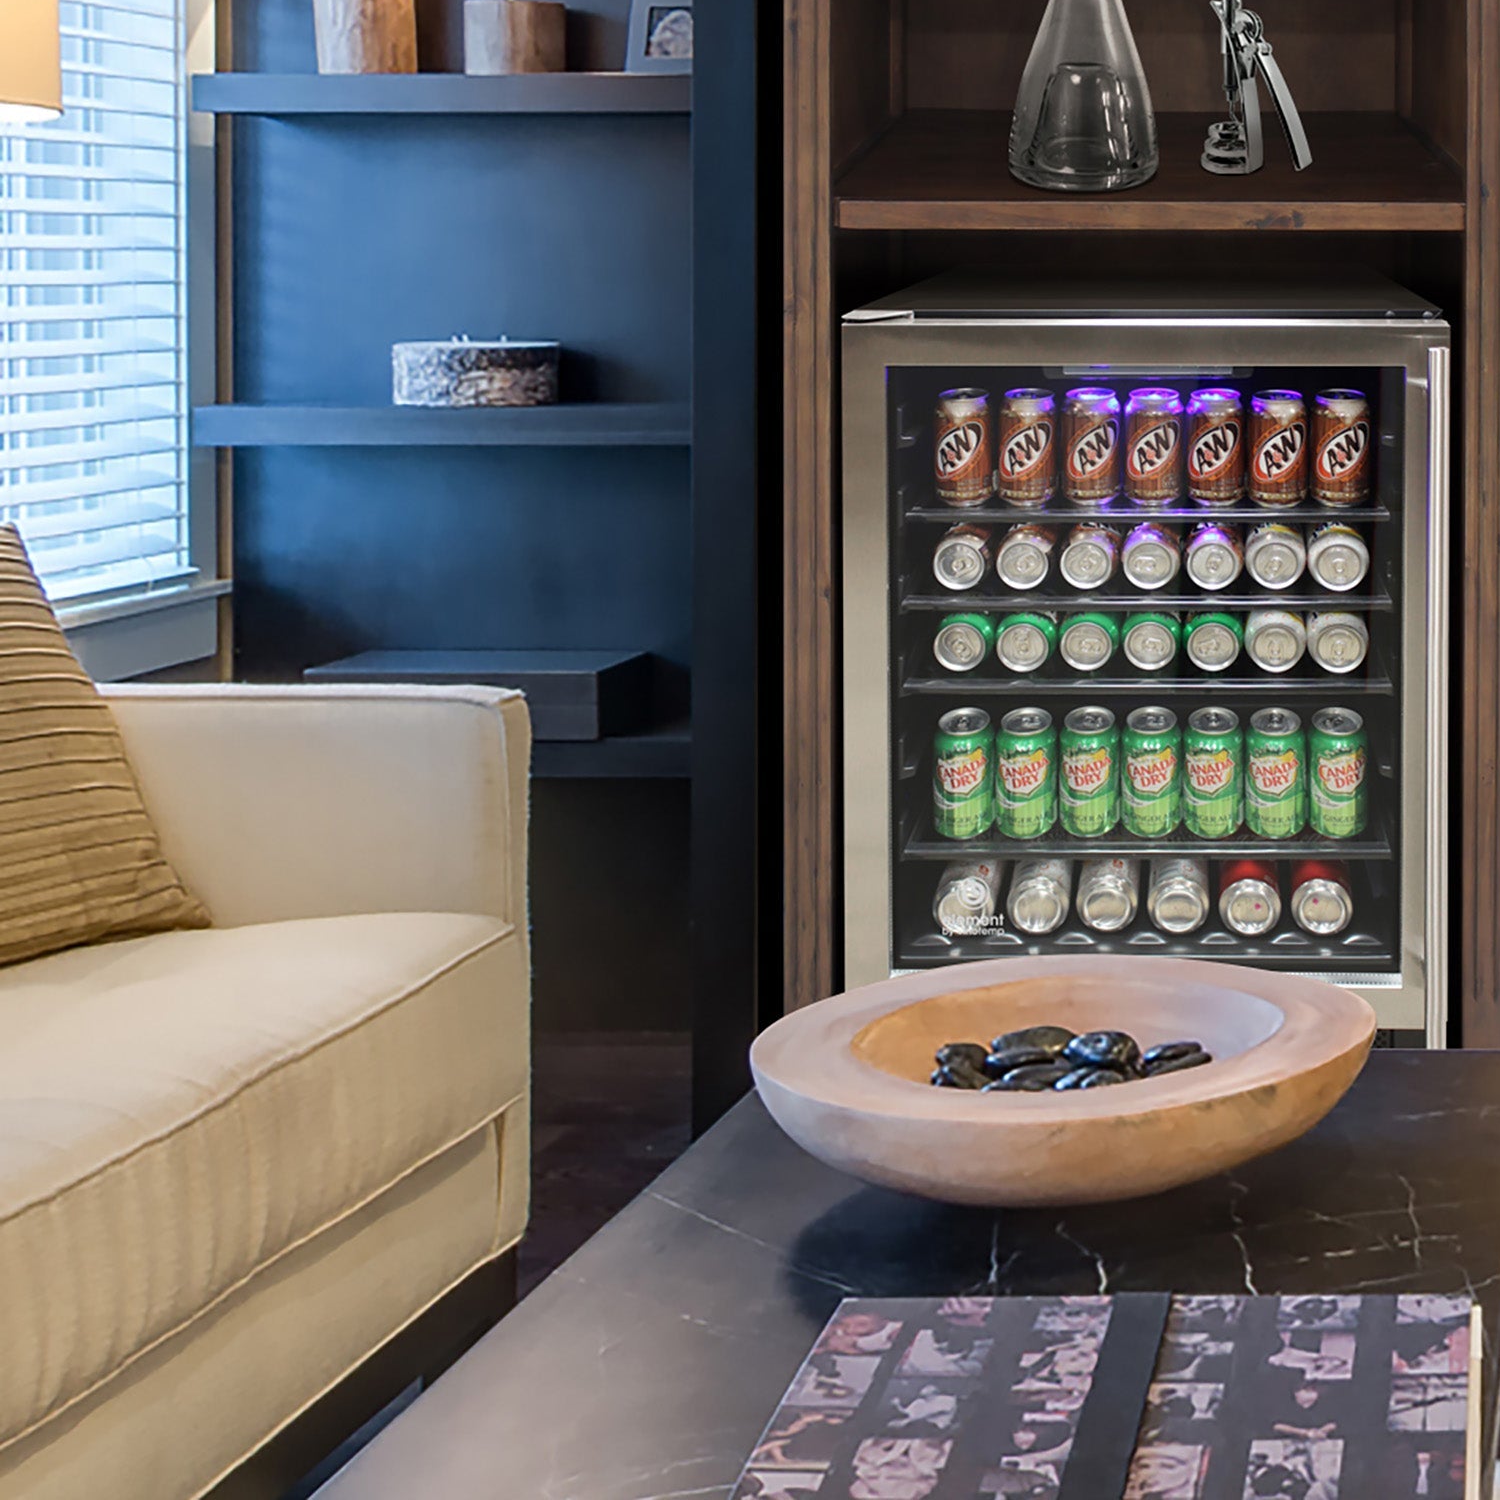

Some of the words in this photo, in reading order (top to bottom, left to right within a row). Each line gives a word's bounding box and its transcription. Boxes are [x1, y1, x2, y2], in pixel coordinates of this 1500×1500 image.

[936, 756, 988, 782] CANADA
[999, 756, 1050, 781] CANADA
[1062, 756, 1112, 779] CANADA
[1126, 754, 1177, 780] CANADA
[1186, 757, 1235, 779] CANADA
[1249, 757, 1300, 781] CANADA
[950, 770, 979, 789] DRY
[1011, 771, 1040, 789] DRY
[1074, 769, 1102, 788] DRY
[1140, 769, 1168, 788] DRY
[1196, 770, 1224, 787] DRY
[1262, 772, 1291, 789] DRY
[1334, 770, 1361, 789] DRY
[942, 913, 1005, 927] element
